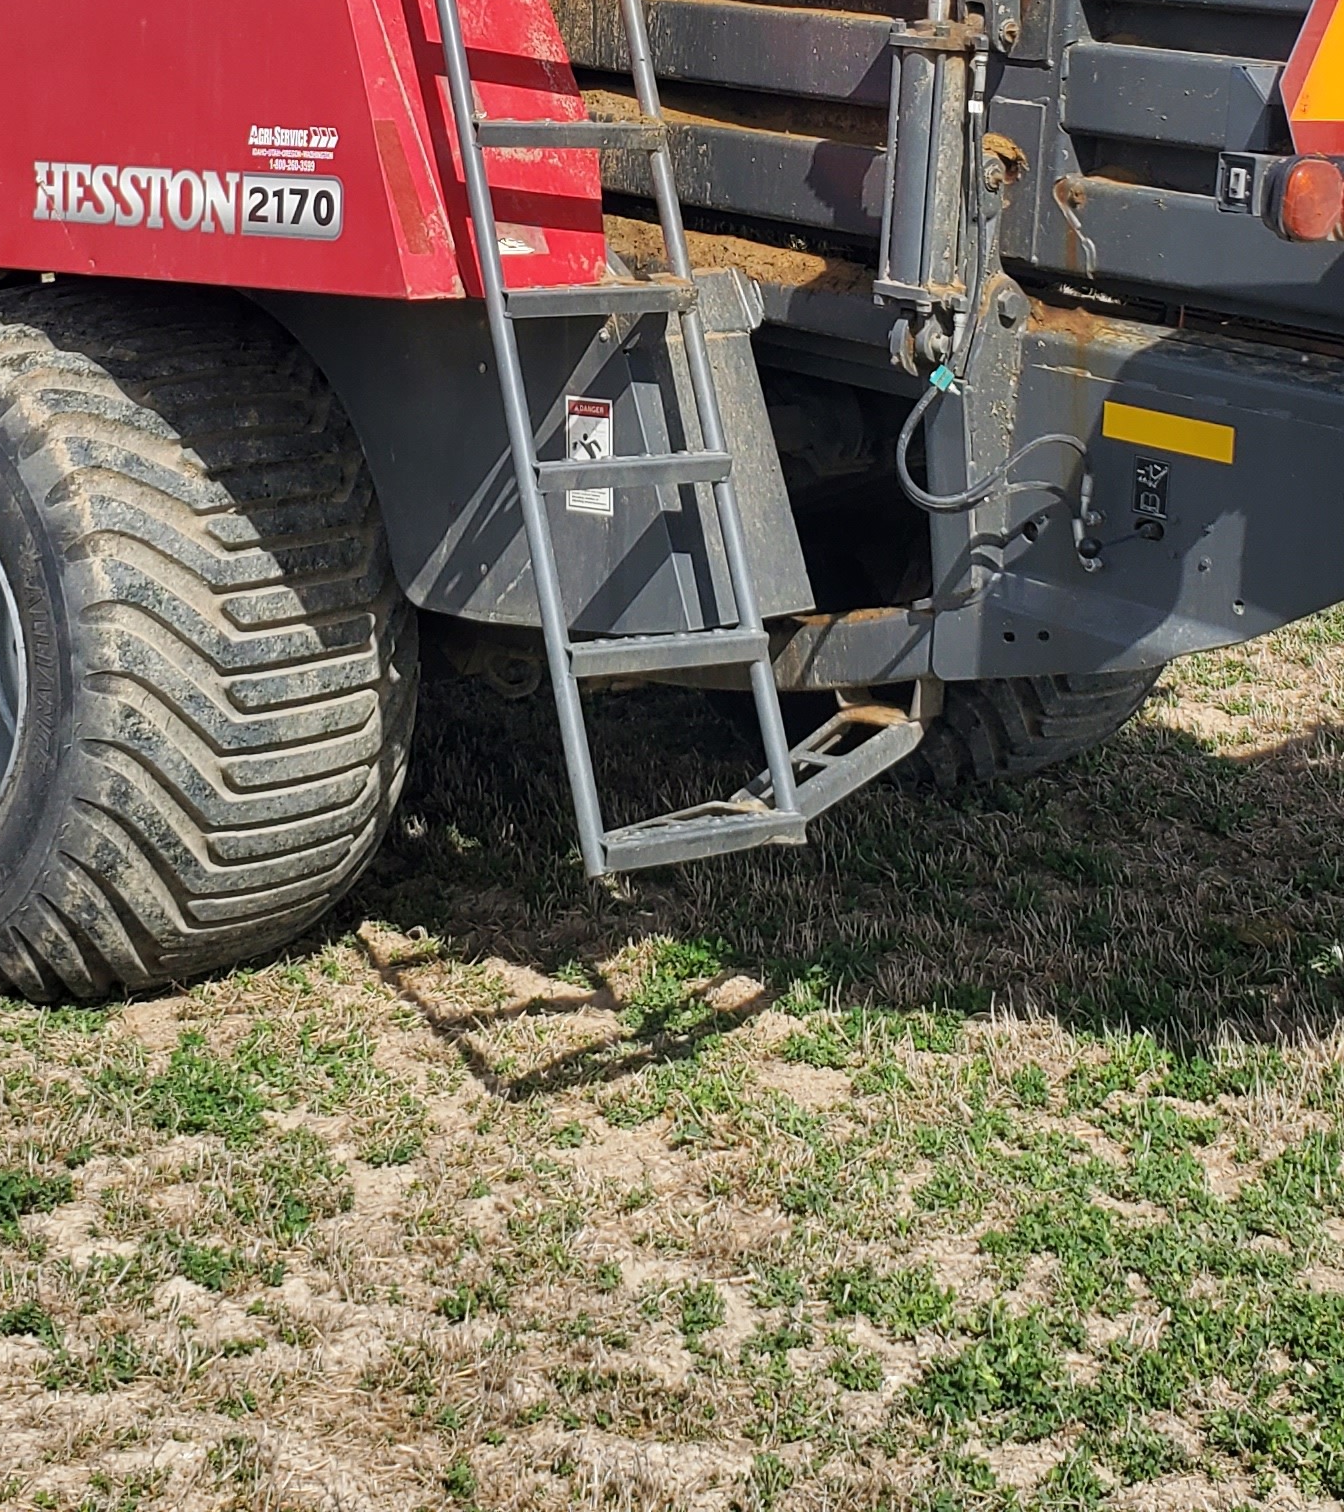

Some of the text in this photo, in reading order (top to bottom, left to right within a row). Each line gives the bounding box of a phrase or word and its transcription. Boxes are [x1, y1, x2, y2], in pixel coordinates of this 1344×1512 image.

[33, 161, 336, 235] HESSTON 2170
[579, 405, 604, 414] DANGER
